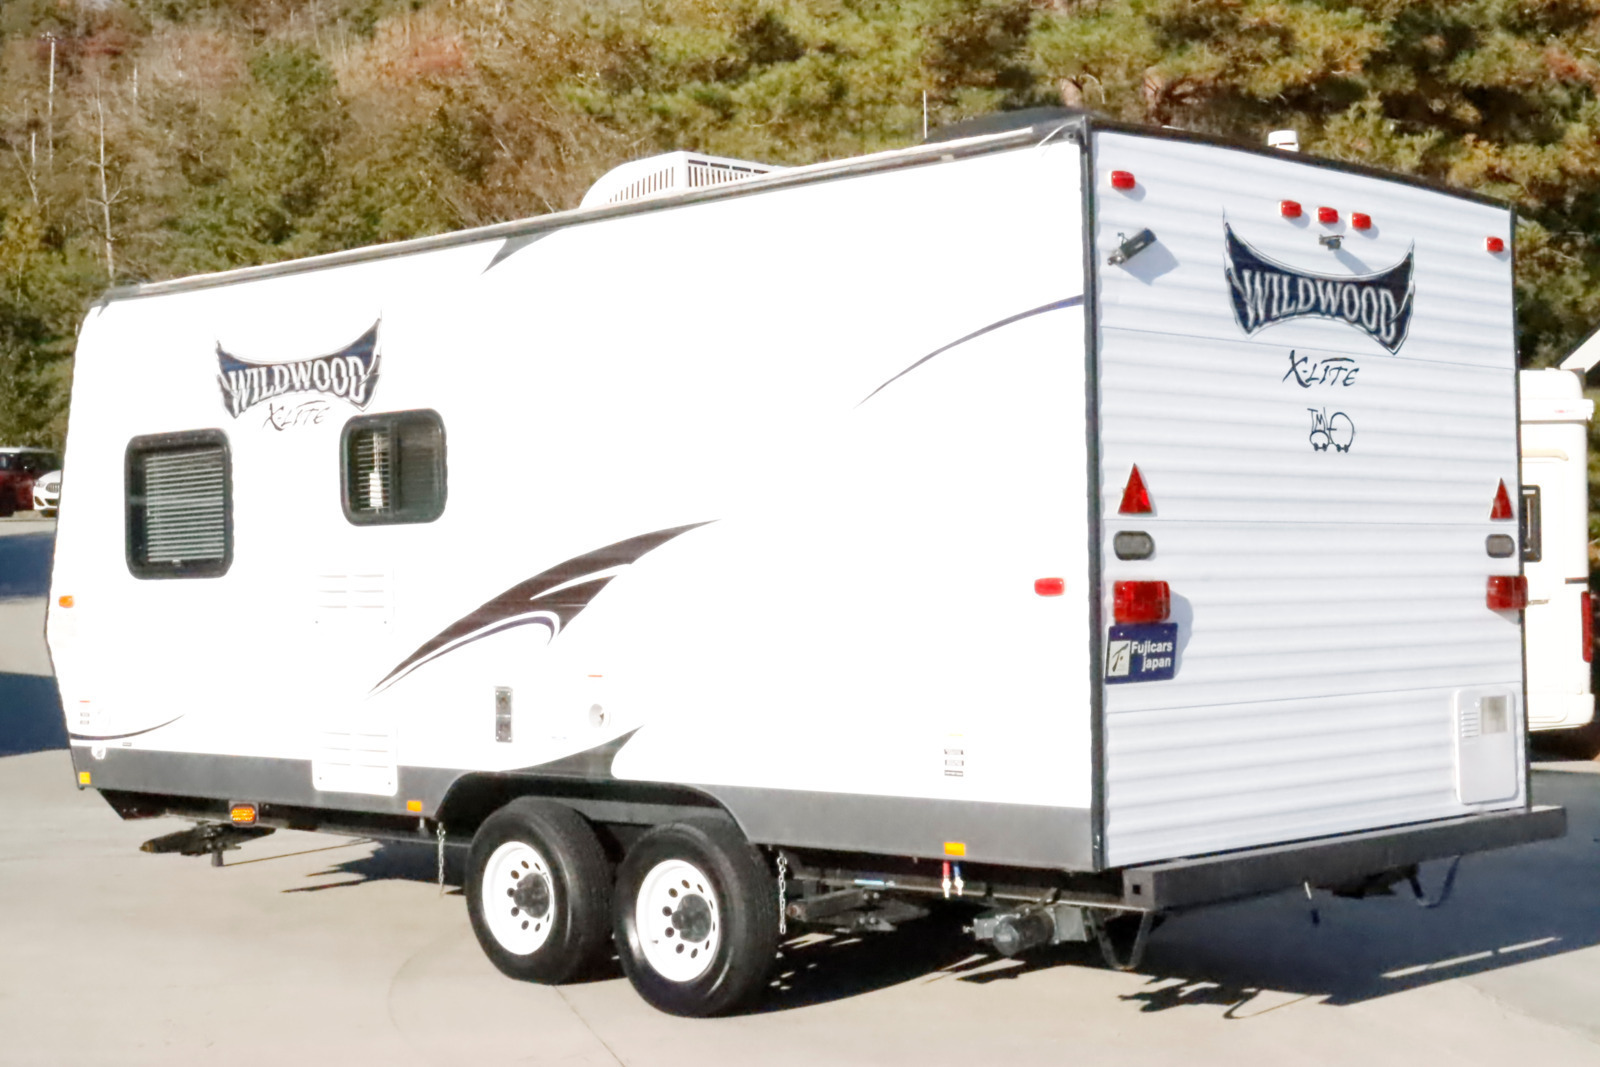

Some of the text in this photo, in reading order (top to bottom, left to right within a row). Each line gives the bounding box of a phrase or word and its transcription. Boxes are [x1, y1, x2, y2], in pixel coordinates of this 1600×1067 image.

[1242, 269, 1397, 344] WILDWOOD
[228, 355, 367, 417] WILDWOOD
[1282, 349, 1360, 388] X-LITE
[263, 400, 331, 431] X-LITE
[1131, 639, 1173, 656] Fujicars
